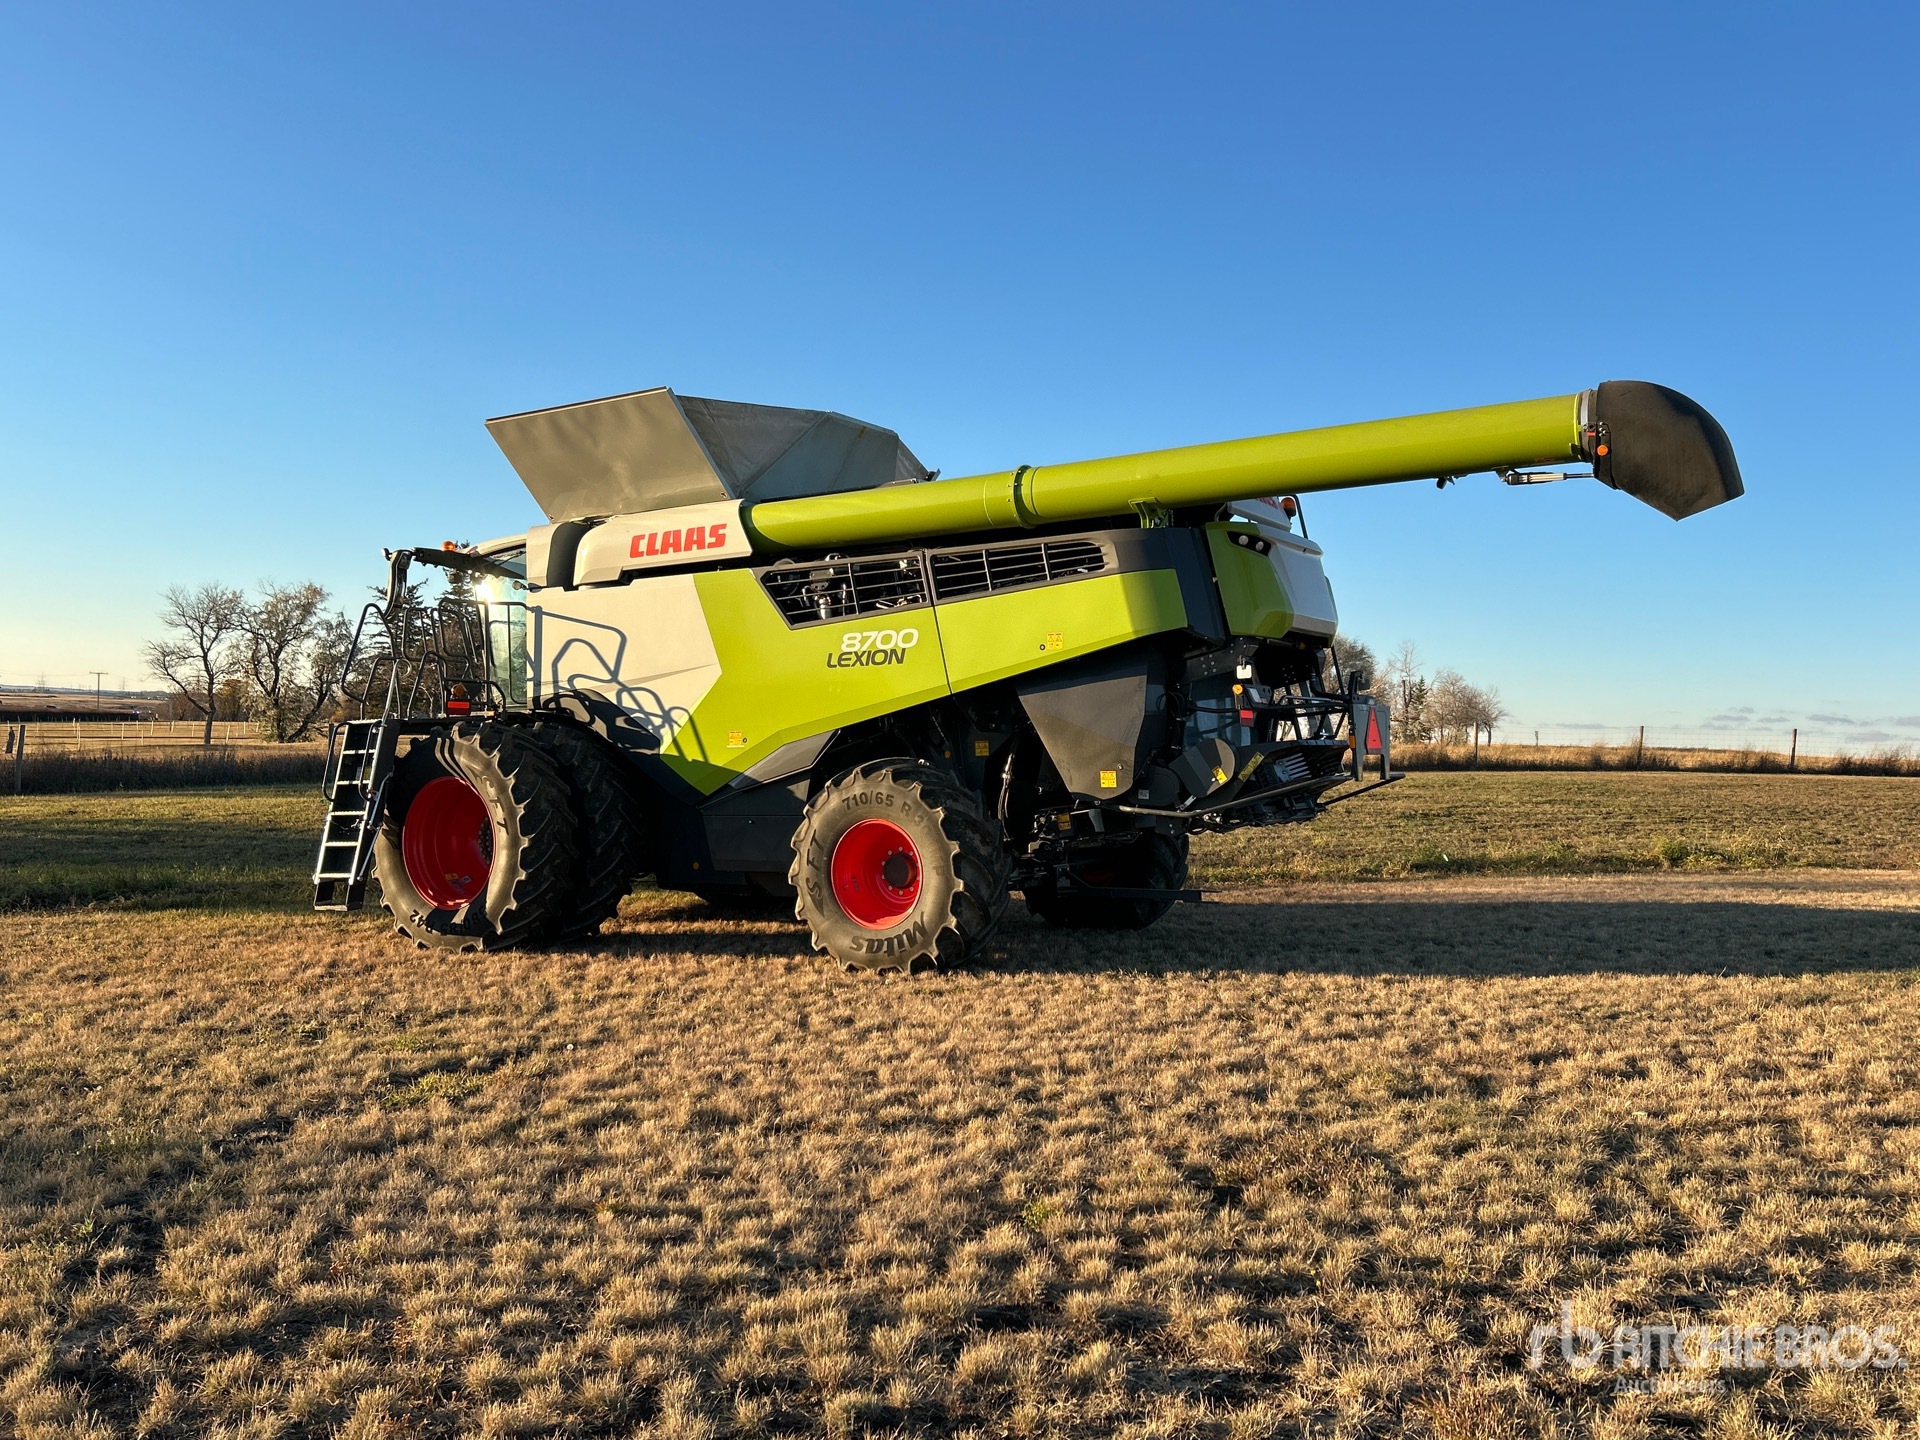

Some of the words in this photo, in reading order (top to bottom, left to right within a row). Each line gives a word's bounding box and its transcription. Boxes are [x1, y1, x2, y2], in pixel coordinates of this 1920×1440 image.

[629, 523, 727, 558] CLAAS
[841, 628, 918, 651] 8700
[826, 648, 906, 668] LEXION
[842, 791, 895, 810] 710/65
[901, 801, 913, 817] R
